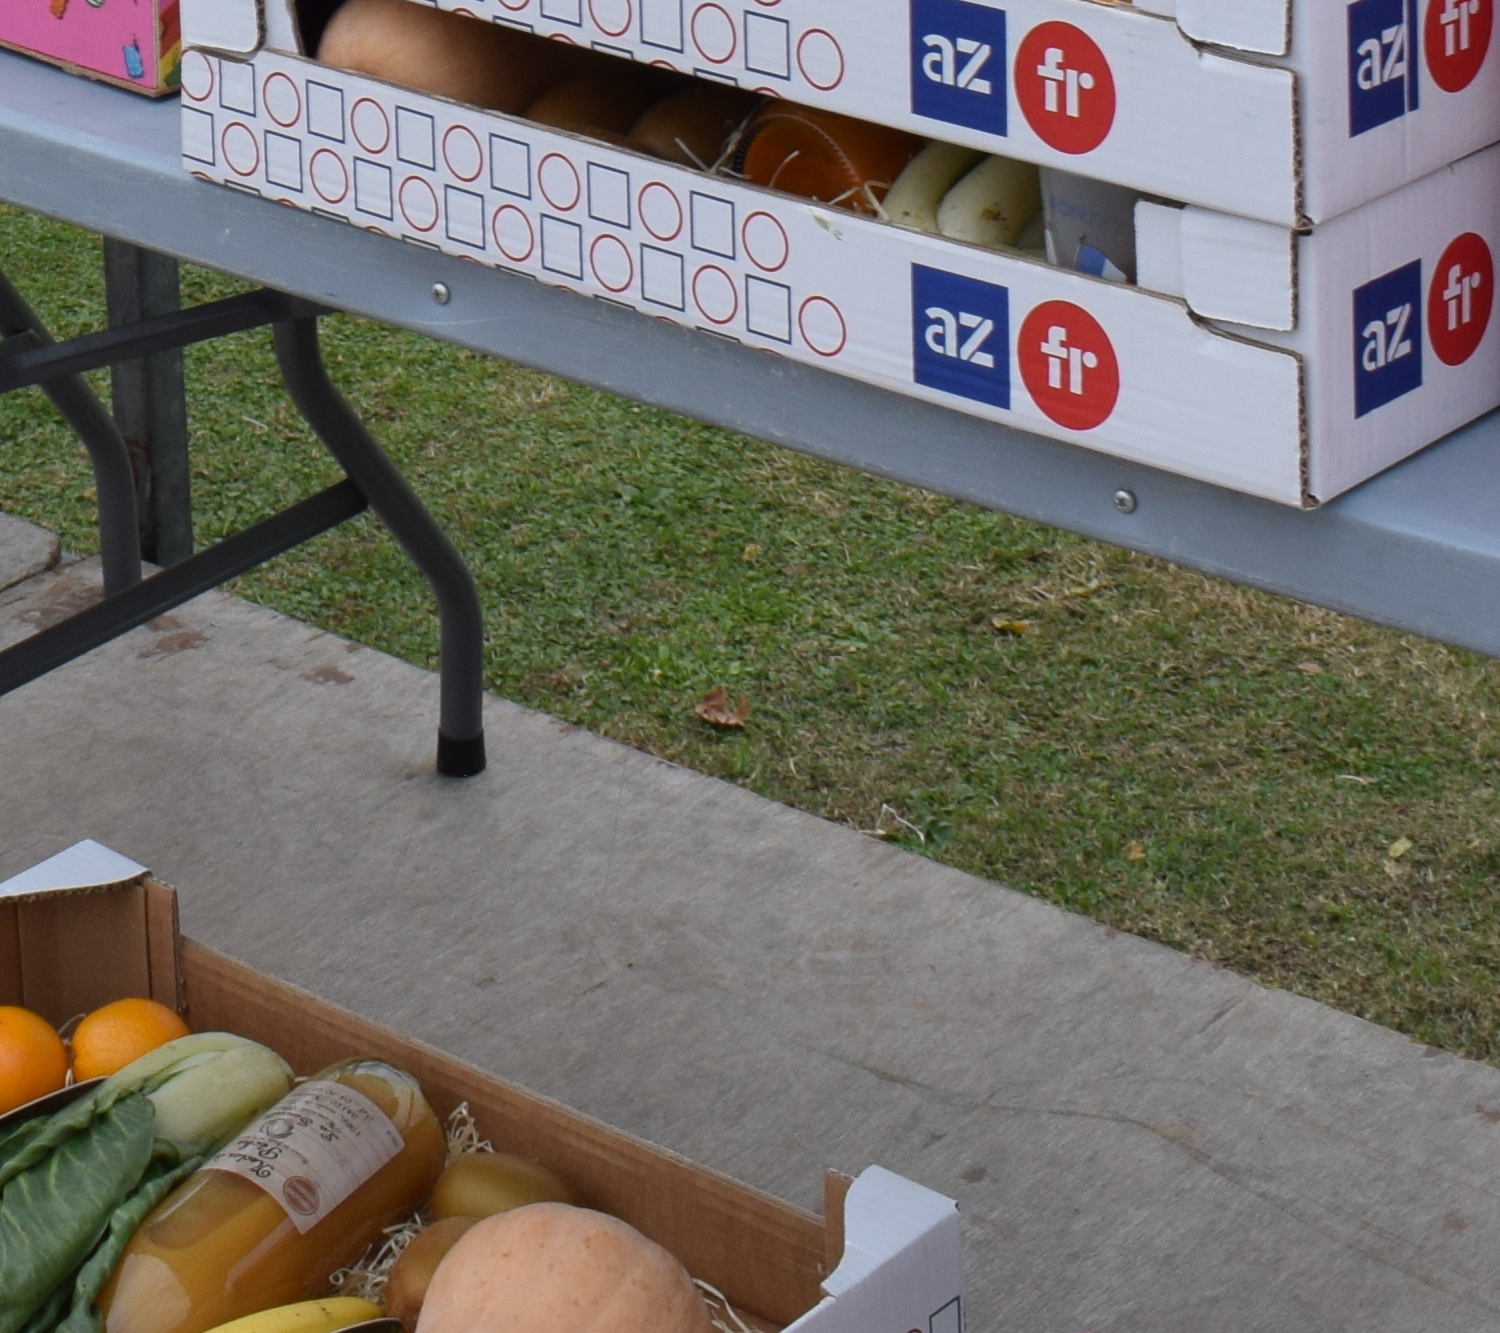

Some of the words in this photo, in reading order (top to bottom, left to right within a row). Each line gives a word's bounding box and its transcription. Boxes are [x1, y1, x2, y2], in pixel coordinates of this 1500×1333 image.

[920, 33, 993, 96] az
[1036, 47, 1093, 119] fr
[1355, 23, 1409, 91] az
[923, 304, 994, 371] az
[1040, 325, 1098, 396] fr
[1361, 301, 1412, 372] az
[1442, 264, 1481, 333] fr
